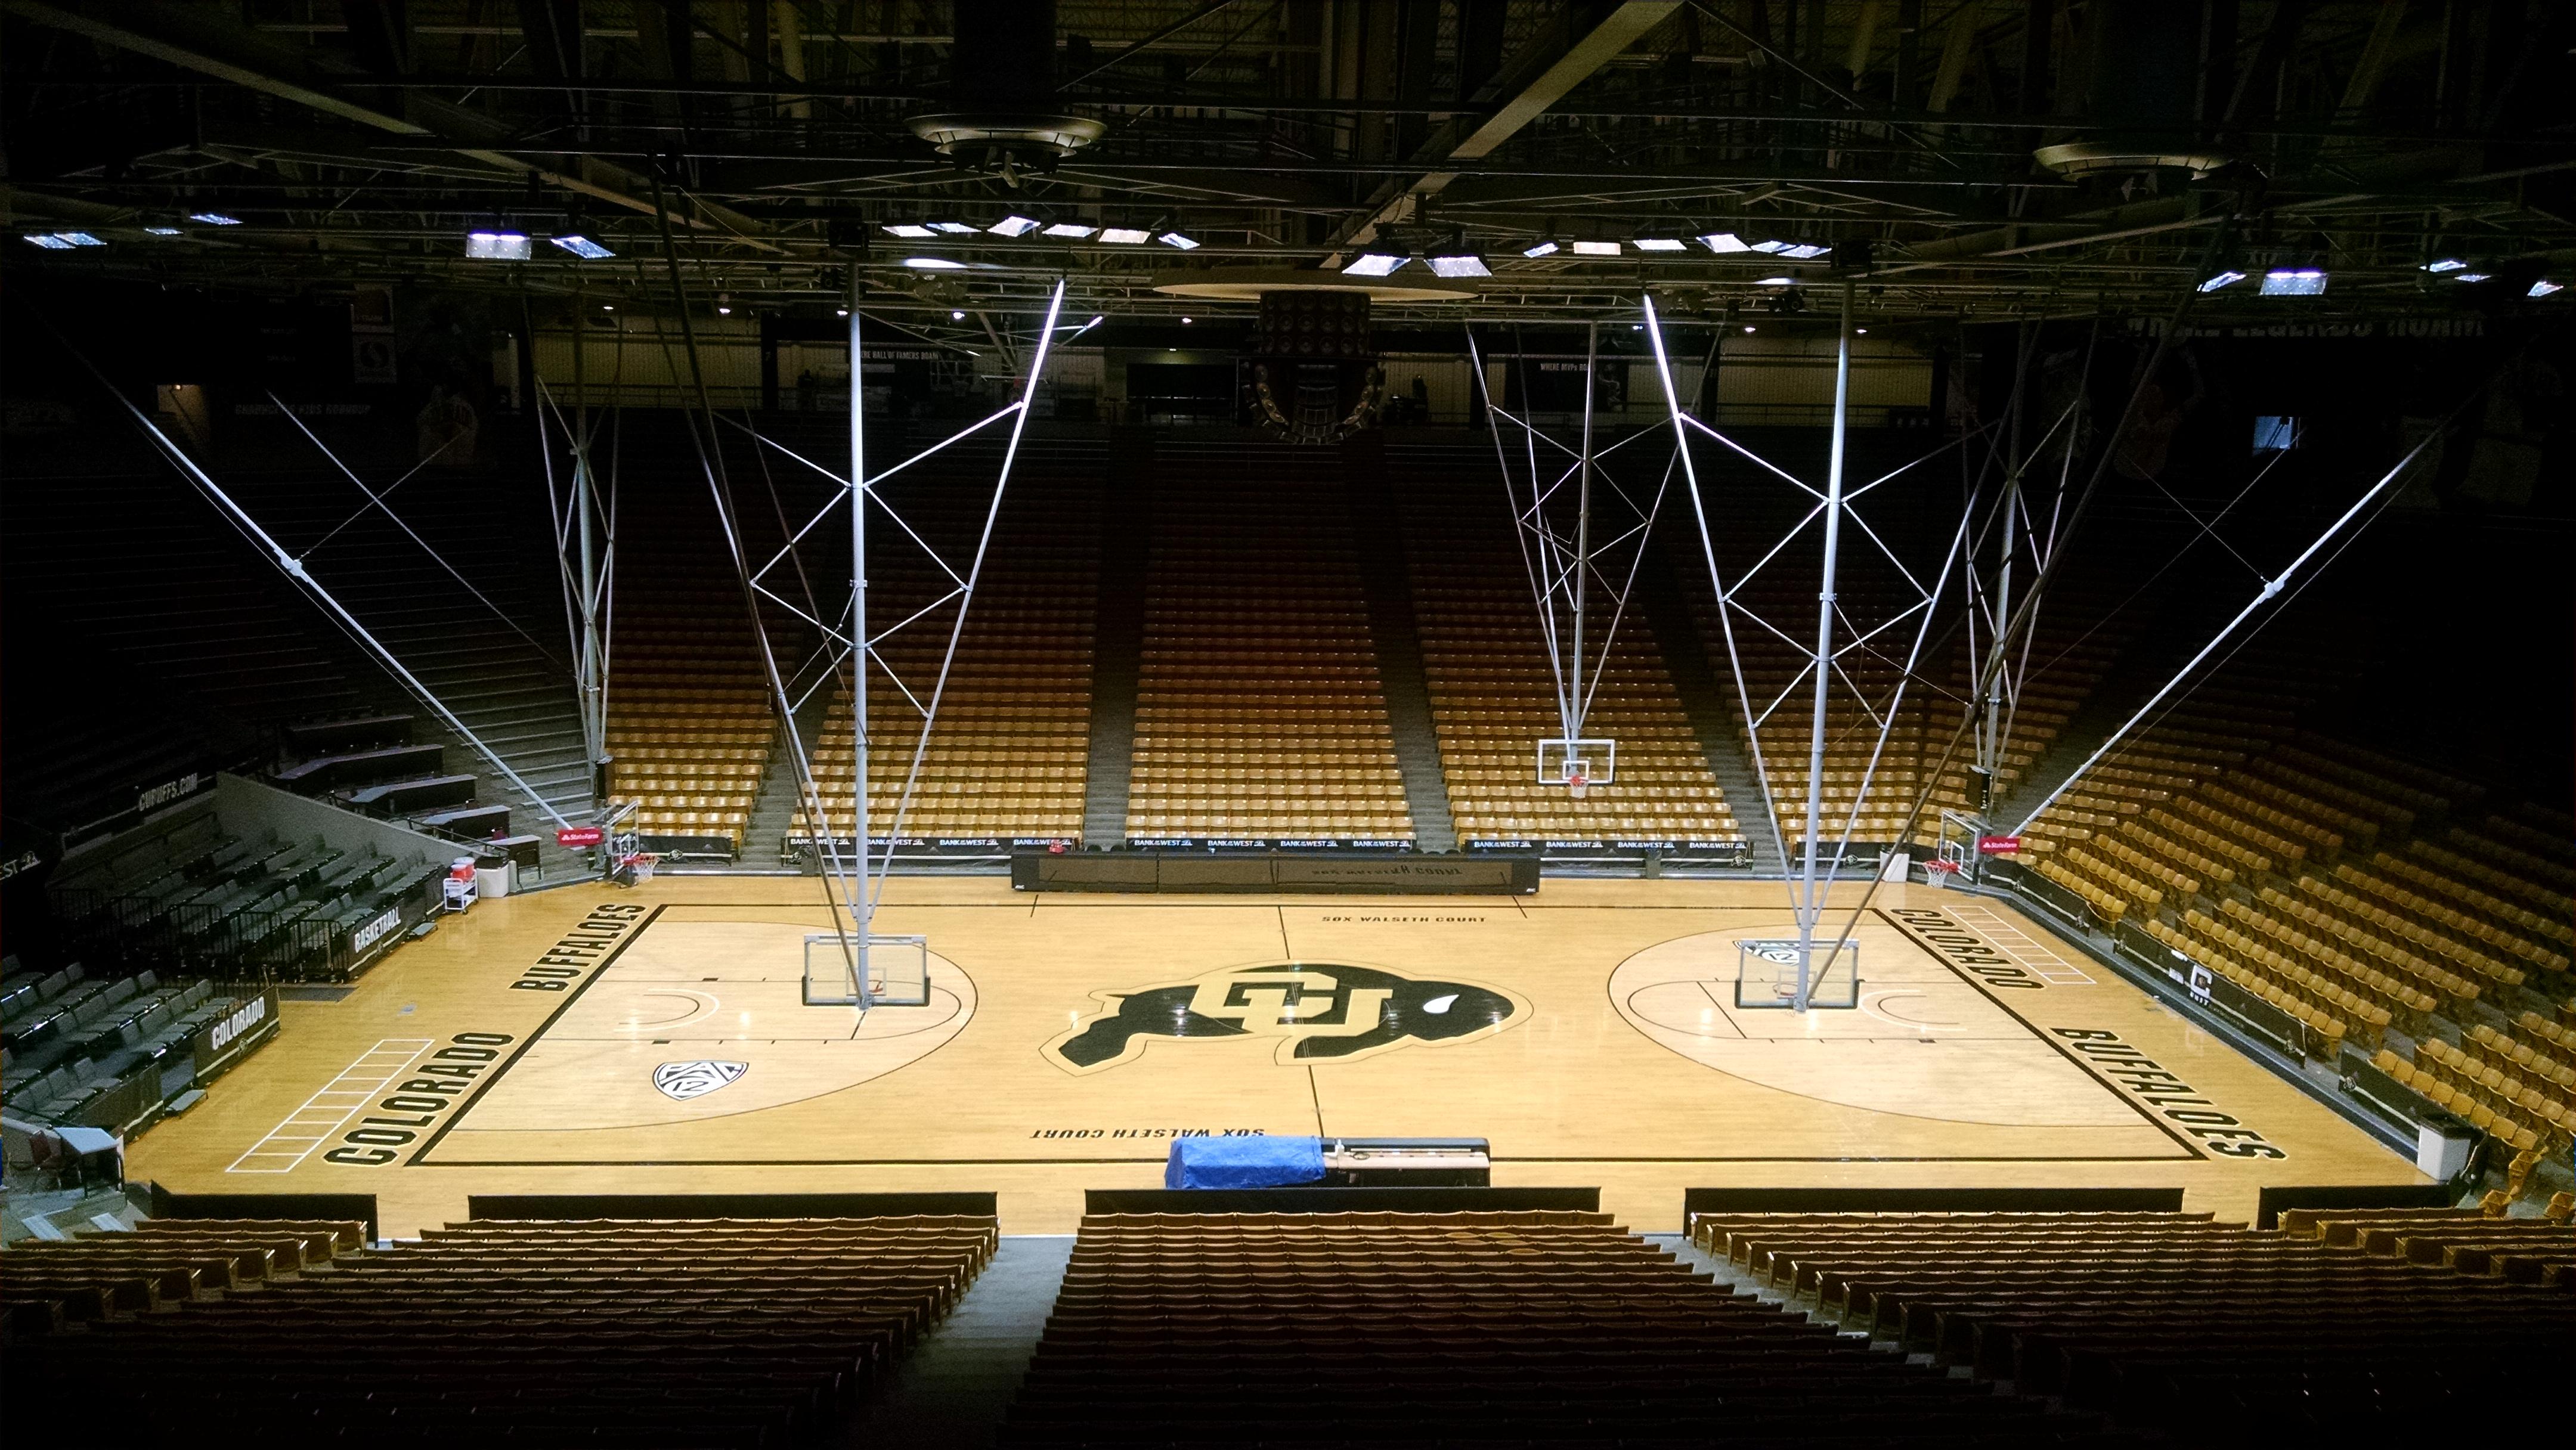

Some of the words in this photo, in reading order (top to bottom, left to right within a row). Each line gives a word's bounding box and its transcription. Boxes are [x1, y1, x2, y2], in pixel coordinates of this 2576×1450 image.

[355, 906, 401, 953] BASKETBALL
[508, 904, 647, 992] BUFFALOES
[1890, 909, 2046, 989] COLORADO
[212, 996, 265, 1051] COLORADO
[323, 1032, 515, 1166] COLORADO
[2049, 1028, 2289, 1160] BUFFALOES
[1029, 1129, 1105, 1139] COURT
[1111, 1128, 1210, 1138] WALSETH
